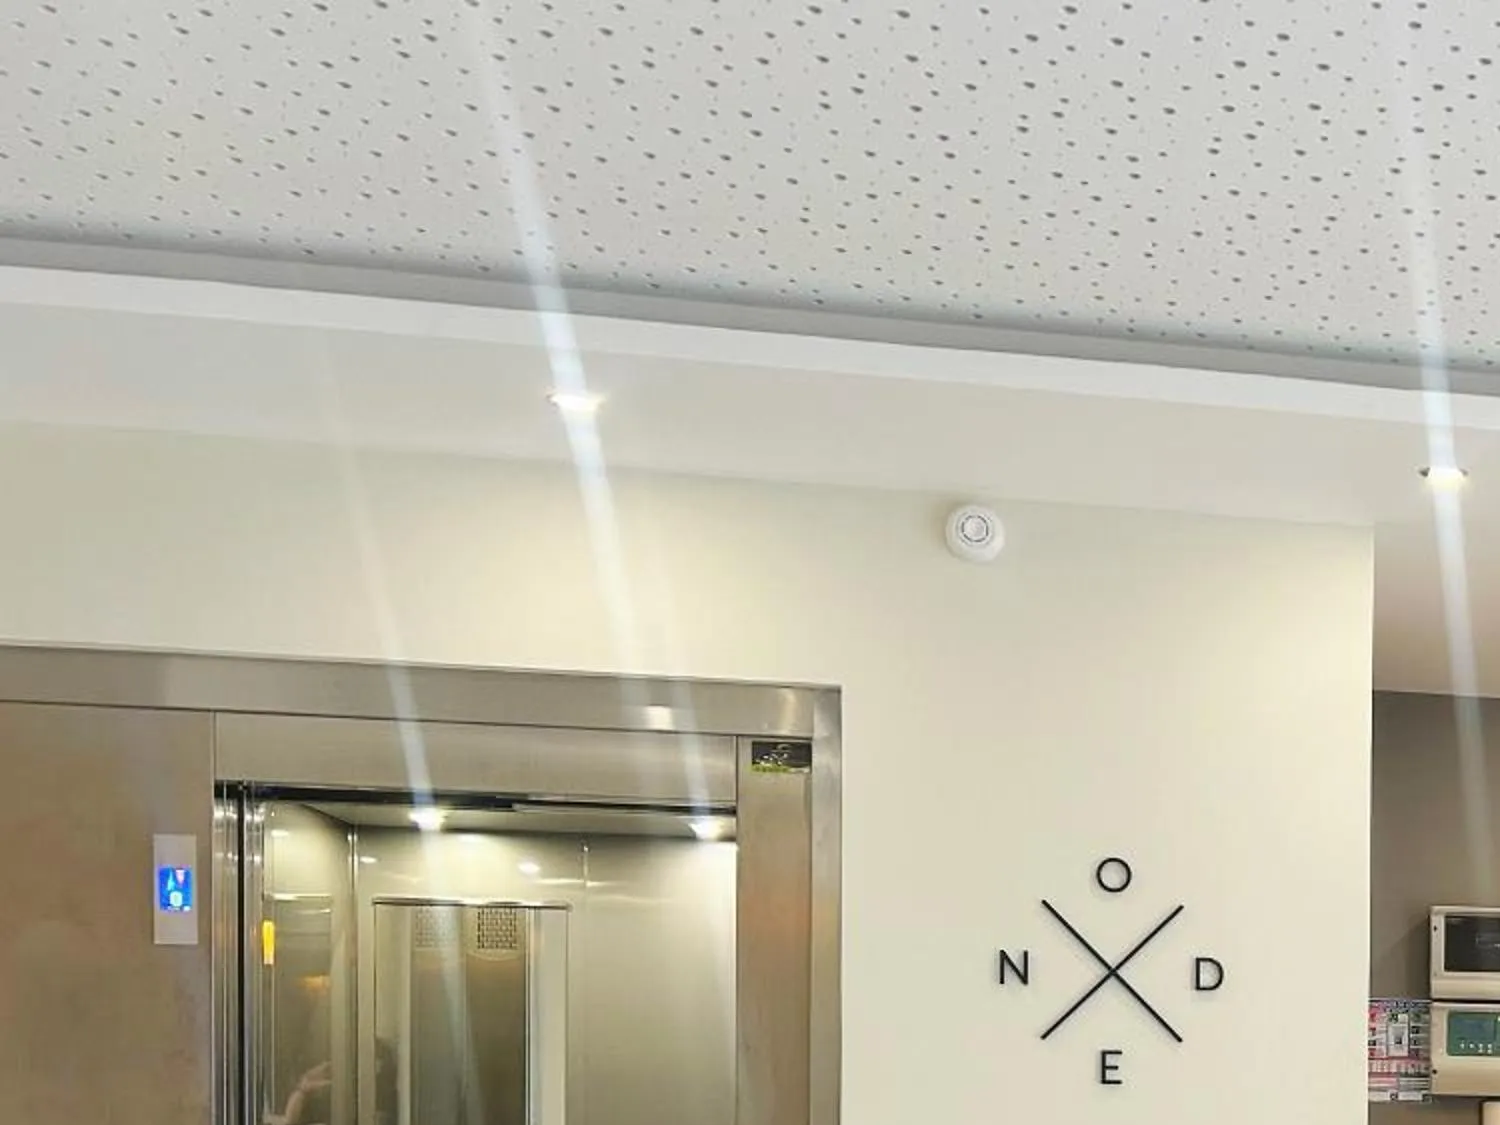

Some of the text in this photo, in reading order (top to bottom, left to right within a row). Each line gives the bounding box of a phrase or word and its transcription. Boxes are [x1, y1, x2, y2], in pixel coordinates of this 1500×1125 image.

[1096, 857, 1132, 893] O
[999, 949, 1029, 985] N
[1194, 957, 1224, 991] D
[1100, 1050, 1123, 1085] E
